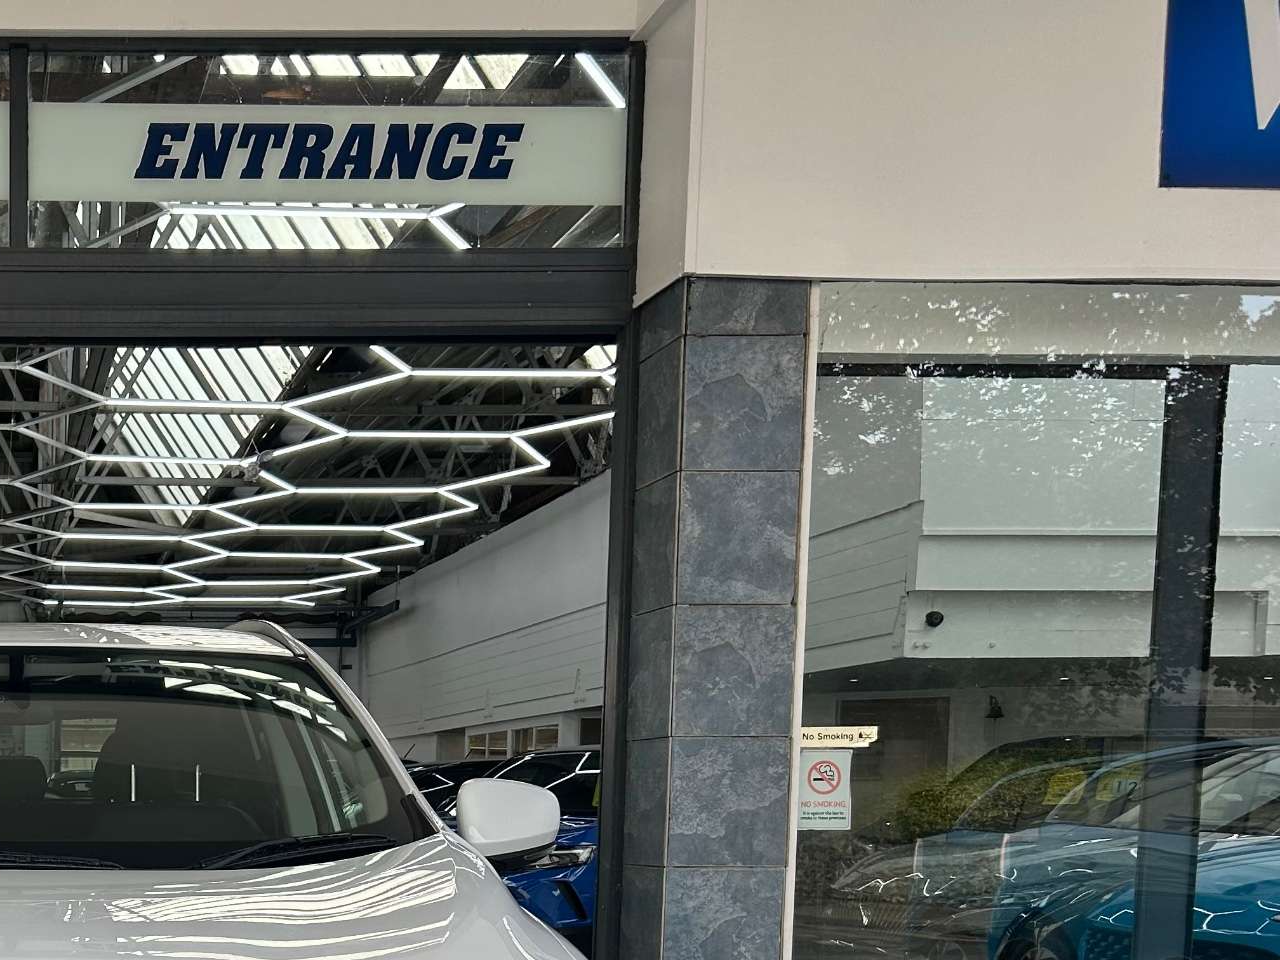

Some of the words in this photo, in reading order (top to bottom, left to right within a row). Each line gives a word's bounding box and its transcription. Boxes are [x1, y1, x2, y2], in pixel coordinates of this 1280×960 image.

[134, 122, 524, 180] ENTRANCE
[802, 733, 815, 741] No
[817, 732, 854, 741] Smoking
[800, 800, 811, 808] NO
[812, 800, 847, 808] SMOKING
